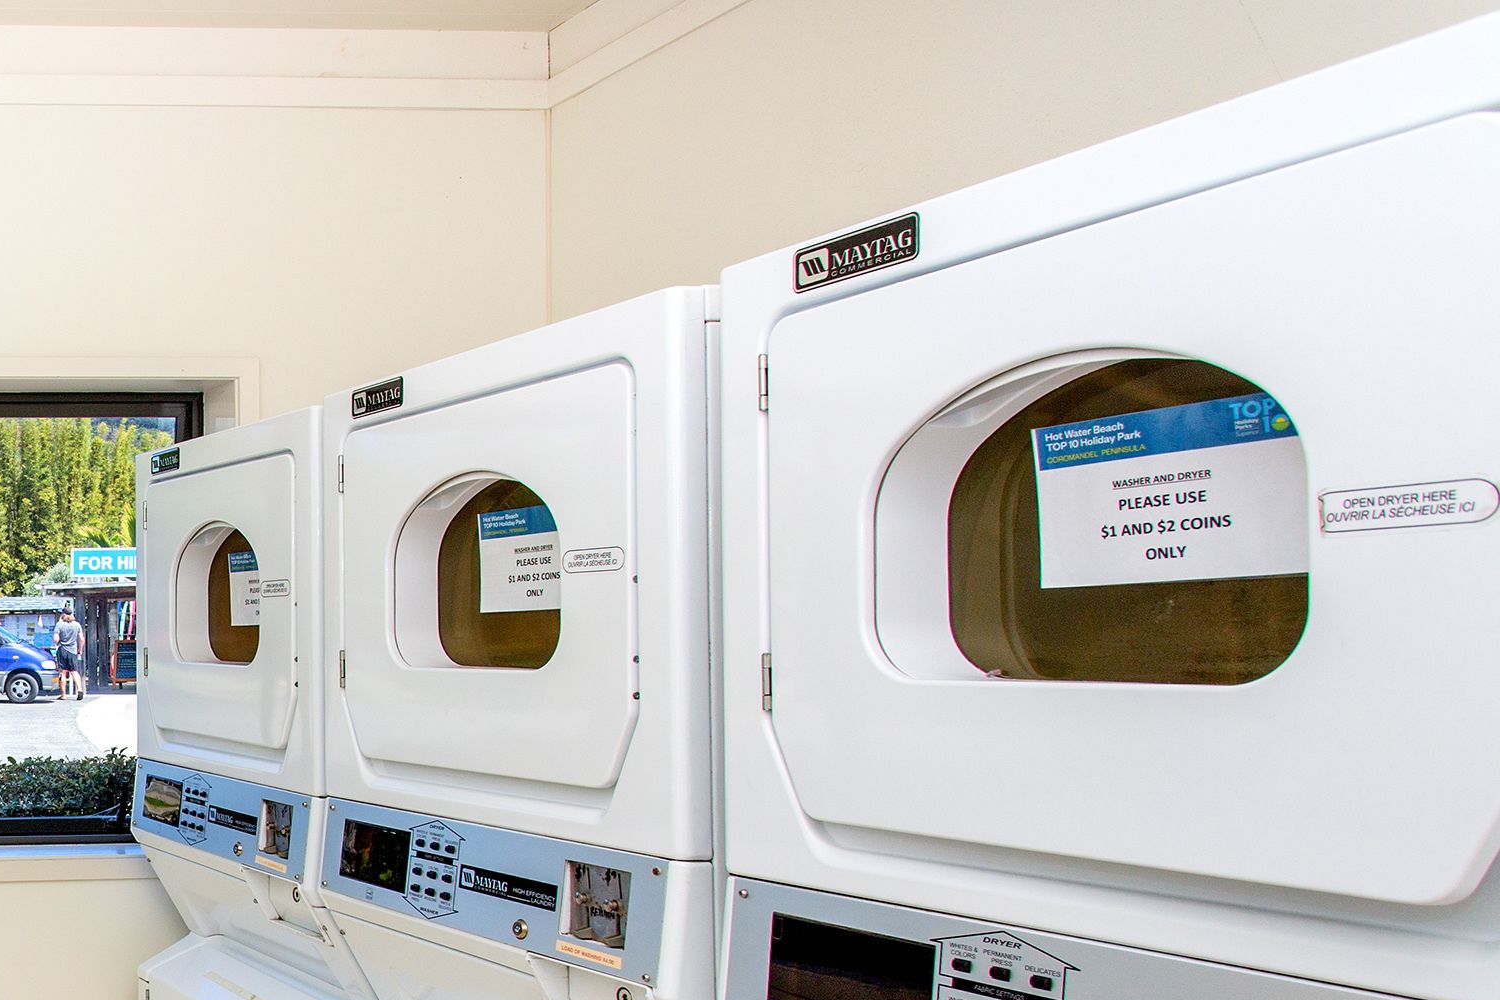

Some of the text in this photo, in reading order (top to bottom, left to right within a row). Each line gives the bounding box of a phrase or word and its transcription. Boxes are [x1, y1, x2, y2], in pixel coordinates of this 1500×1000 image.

[831, 228, 912, 270] MAYTAG
[831, 249, 912, 277] COMMERCIAL
[1228, 398, 1276, 419] TOP
[1045, 421, 1125, 442] Hot Water Beach
[1046, 430, 1141, 452] TOP 10 Holiday Park
[1047, 444, 1147, 465] COROMANDEL PENINSULA
[1112, 469, 1212, 489] WASHER AND DRYER
[1118, 490, 1207, 511] PLEASE USE
[1343, 489, 1457, 510] OPEN DRYER HERE
[1326, 501, 1475, 523] OUVRIR LA SÉCHEUSE ICI
[1101, 514, 1232, 540] $1 AND $2 COINS
[514, 546, 530, 555] WASHER
[1145, 545, 1187, 561] ONLY
[79, 556, 113, 570] FOR
[516, 556, 552, 567] PLEASE USE
[508, 571, 561, 584] $1 AND $2 COINS
[526, 589, 544, 598] ONLY
[475, 875, 508, 893] MAYTAG
[512, 887, 556, 902] HIGH EFFICIENCY
[530, 897, 555, 909] LAUNDRY
[950, 942, 973, 952] WHITES
[983, 936, 1022, 950] DRYER
[950, 949, 976, 960] COLORS
[983, 948, 1022, 962] PERMANENT
[991, 957, 1013, 968] PRESS
[1025, 964, 1061, 978] DELICATES
[974, 984, 995, 996] FABRIC
